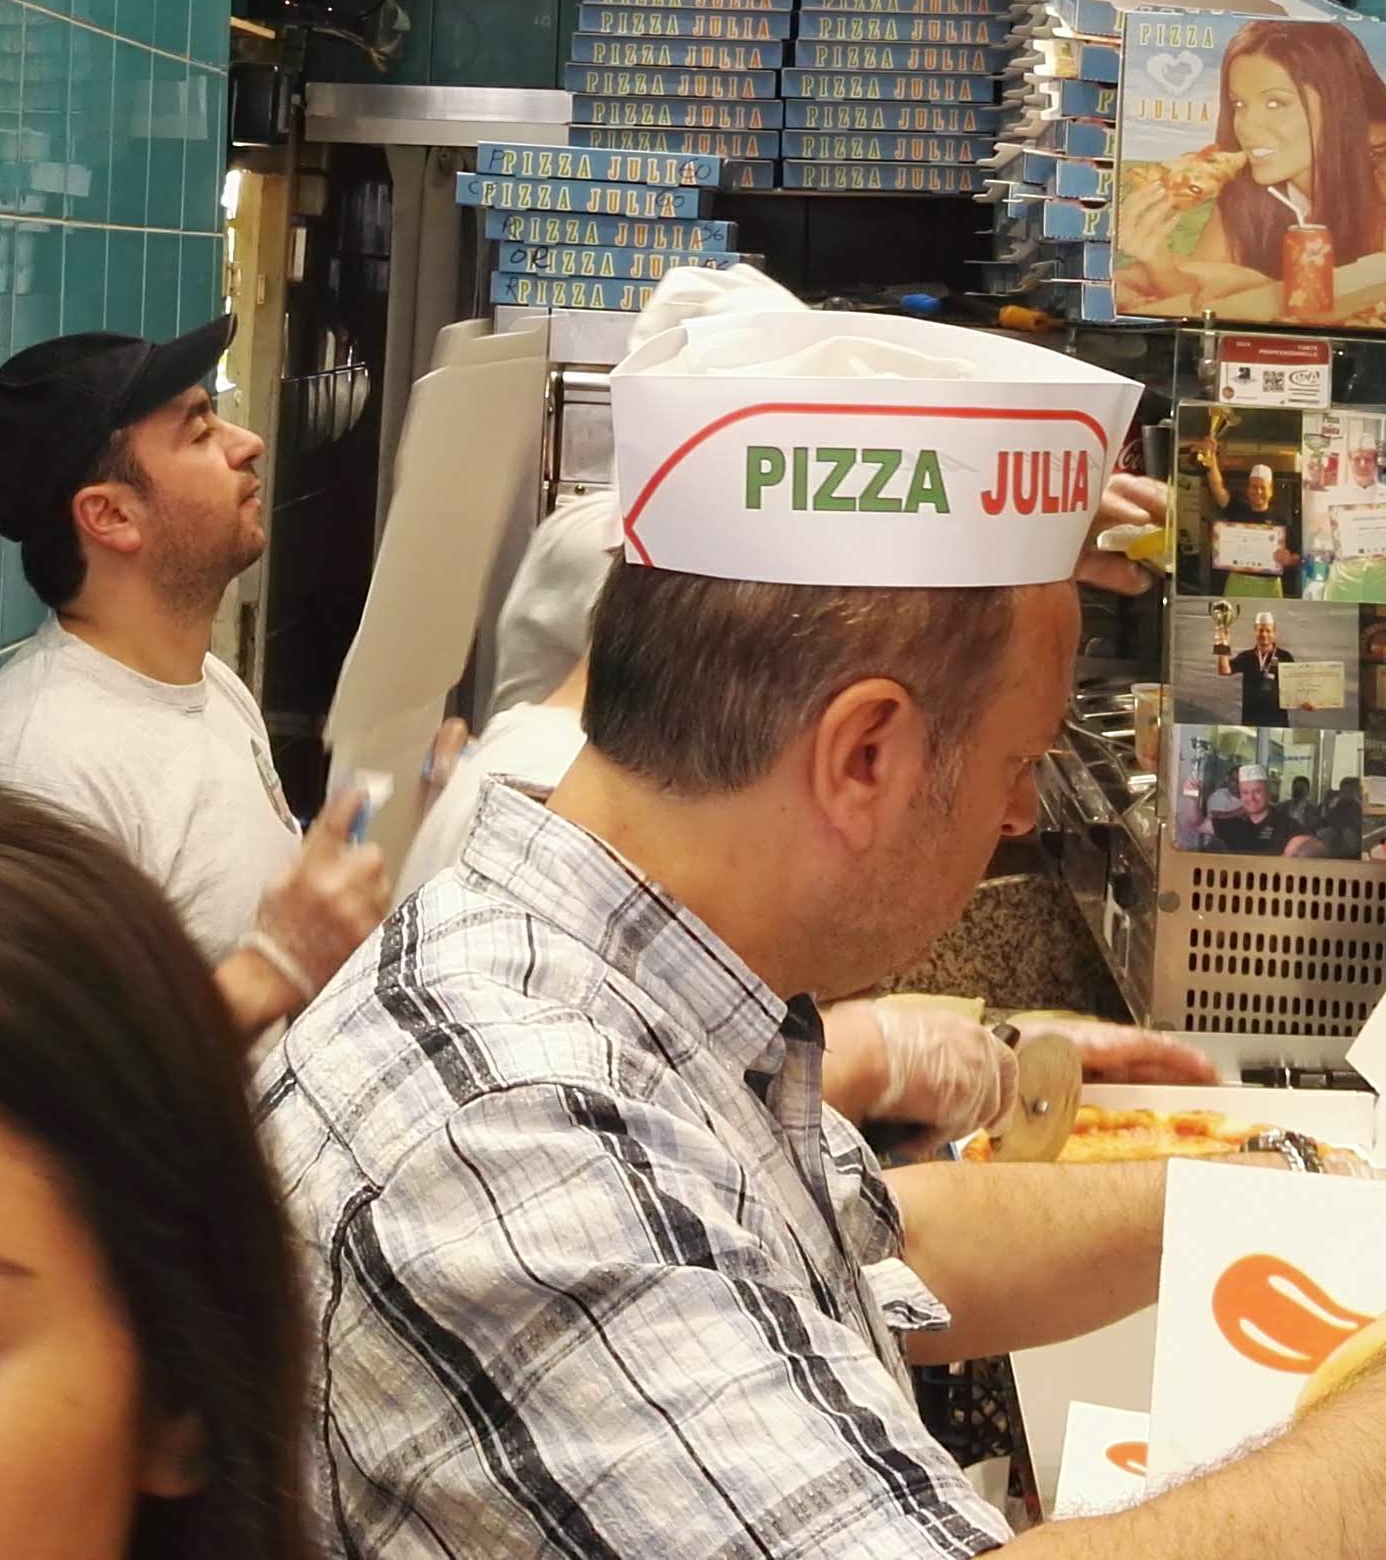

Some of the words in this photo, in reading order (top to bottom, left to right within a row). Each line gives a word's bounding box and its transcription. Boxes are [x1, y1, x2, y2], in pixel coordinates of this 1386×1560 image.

[601, 11, 679, 35] PIZZA
[693, 15, 770, 39] JULIA
[819, 17, 897, 40] PIZZA
[911, 20, 989, 43] JULIA
[1140, 23, 1215, 48] PIZZA
[593, 42, 671, 66] PIZZA
[684, 45, 762, 69] JULIA
[815, 46, 893, 68] PIZZA
[908, 48, 985, 71] JULIA
[586, 72, 664, 95] PIZZA
[678, 74, 755, 98] JULIA
[801, 76, 881, 98] PIZZA
[894, 78, 972, 101] JULIA
[593, 102, 671, 125] PIZZA
[684, 105, 762, 128] JULIA
[806, 106, 885, 129] PIZZA
[898, 108, 976, 131] JULIA
[1136, 97, 1211, 122] JULIA
[590, 130, 667, 152] PIZZA
[681, 133, 759, 158] JULIA
[803, 137, 881, 159] PIZZA
[894, 139, 972, 161] JULIA
[502, 150, 592, 179] PIZZA
[607, 156, 697, 186] JULIA
[803, 167, 881, 189] PIZZA
[895, 168, 972, 190] JULIA
[481, 181, 572, 211] PIZZA
[586, 188, 676, 217] JULIA
[508, 216, 599, 245] PIZZA
[614, 222, 703, 251] JULIA
[517, 279, 605, 308] PIZZA
[744, 445, 951, 515] PIZZA
[980, 450, 1090, 516] JULIA
